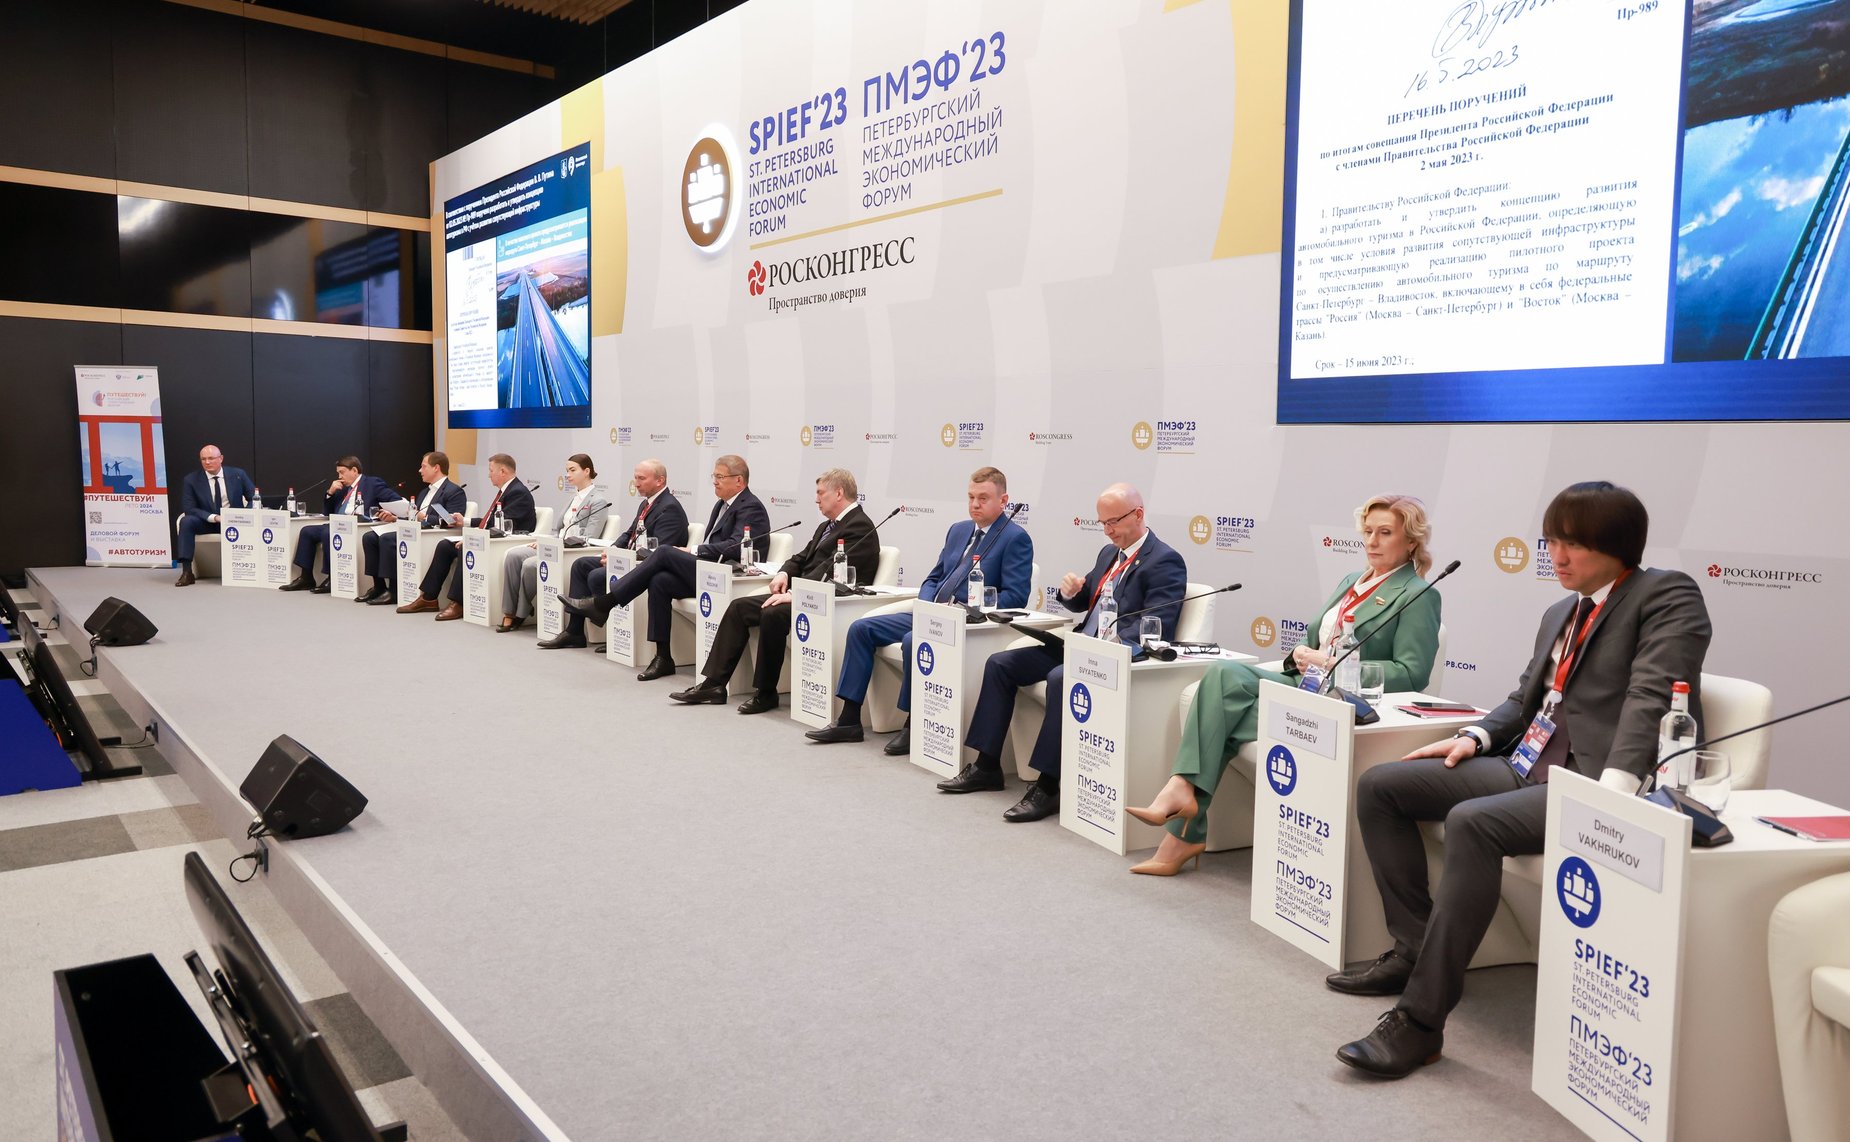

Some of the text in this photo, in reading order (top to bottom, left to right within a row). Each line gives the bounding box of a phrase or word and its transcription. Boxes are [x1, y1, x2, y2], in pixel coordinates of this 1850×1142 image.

[1617, 1, 1658, 20] Пр-989
[863, 30, 1006, 118] ПМЭФ'23
[749, 86, 848, 155] SPIEF'23
[863, 87, 981, 143] ПЕТЕРБУРГСКИЙ
[1387, 83, 1527, 125] ПЕРЕЧЕНЬ ПОРУЧЕНИЙ
[863, 106, 1002, 166] МЕЖДУНАРОДНЫЙ
[1332, 143, 1364, 158] итогам
[1366, 133, 1417, 151] совещания
[1420, 121, 1478, 141] Президента
[1482, 106, 1545, 128] Российской
[1548, 93, 1614, 115] Федерации
[1342, 156, 1381, 170] членами
[1383, 141, 1458, 163] Правительства
[1461, 127, 1522, 148] Российской
[1525, 115, 1590, 136] Федерации
[750, 139, 834, 178] ST. PETERSBURG
[863, 134, 998, 187] ЭКОНОМИЧЕСКИЙ
[1428, 158, 1447, 169] мая
[1450, 152, 1473, 166] 2023
[750, 159, 838, 197] INTERNATIONAL
[863, 182, 911, 209] ФОРУМ
[750, 188, 807, 217] ECONOMIC
[1331, 218, 1381, 235] разработать
[1429, 205, 1477, 220] утвердить
[1500, 191, 1560, 208] концепцию
[1586, 179, 1638, 198] развития
[1332, 200, 1394, 217] Правительству
[1397, 190, 1451, 206] Российской
[1454, 181, 1511, 198] Федерации:
[750, 214, 786, 237] FORUM
[1298, 236, 1363, 252] автомобильного
[1369, 230, 1403, 246] туризма
[1420, 219, 1475, 235] Российской
[1548, 199, 1637, 219] определяющую
[1309, 257, 1324, 265] том
[1330, 252, 1354, 263] числе
[1361, 246, 1396, 262] условия
[1403, 240, 1444, 257] развития
[1452, 229, 1532, 248] сопутствующей
[1541, 216, 1636, 237] инфраструктуры
[768, 237, 915, 287] РОСКОНГРЕСС
[1317, 280, 1384, 296] осуществлению
[1396, 271, 1473, 287] автомобильного
[1488, 265, 1529, 279] туризма
[1545, 262, 1559, 271] по
[1576, 254, 1634, 270] маршруту
[1319, 261, 1410, 280] предусматривающую
[1429, 252, 1487, 270] реализацию
[1509, 244, 1565, 258] пилотного
[1589, 236, 1635, 251] проекта
[769, 285, 866, 313] Пространство доверия
[1295, 297, 1364, 312] Санкт-Петербург
[1442, 283, 1513, 298] включающему
[1530, 278, 1553, 290] себя
[1558, 273, 1633, 290] федеральные
[1315, 359, 1335, 372] Срок
[1356, 359, 1379, 368] июня
[1381, 355, 1402, 366] 2023
[1333, 539, 1365, 548] ROSCON
[1723, 567, 1822, 584] РОСКОНГРЕСС
[1723, 579, 1765, 588] Пространство
[1286, 712, 1318, 730] Sangadzhi
[1286, 726, 1318, 744] TARBAEV
[1279, 803, 1330, 838] SPIEF'23
[1286, 825, 1322, 846] PETERSBURG
[1594, 819, 1625, 844] Dmitry
[1278, 830, 1324, 856] INTERNATIONAL
[1278, 838, 1308, 858] ECONOMIC
[1278, 847, 1298, 862] FORUM
[1578, 832, 1640, 869] VAKHRUKOV
[1276, 860, 1332, 900] ПМЭФ'23
[1276, 877, 1324, 906] ПЕТЕРБУРГСКИЙ
[1275, 902, 1296, 918] ФОРУМ
[1275, 894, 1329, 928] ЭКОНОМИЧЕСКИЙ
[1276, 886, 1330, 920] МЕЖДУНАРОДНЫЙ
[1573, 961, 1639, 1008] ST. PETERSBURG
[1574, 938, 1650, 998] SPIEF'23
[1572, 973, 1641, 1022] INTERNATIONAL
[1572, 985, 1617, 1020] ECONOMIC
[1572, 996, 1601, 1022] FORUM
[1569, 1038, 1639, 1093] ПЕТЕРБУРГСКИЙ
[1570, 1014, 1652, 1086] ПМЭФ'23
[1568, 1050, 1650, 1114] МЕЖДУНАРОДНЫЙ
[1568, 1072, 1598, 1101] ФОРУМ
[1568, 1060, 1648, 1126] ЭКОНОМИЧЕСКИЙ
